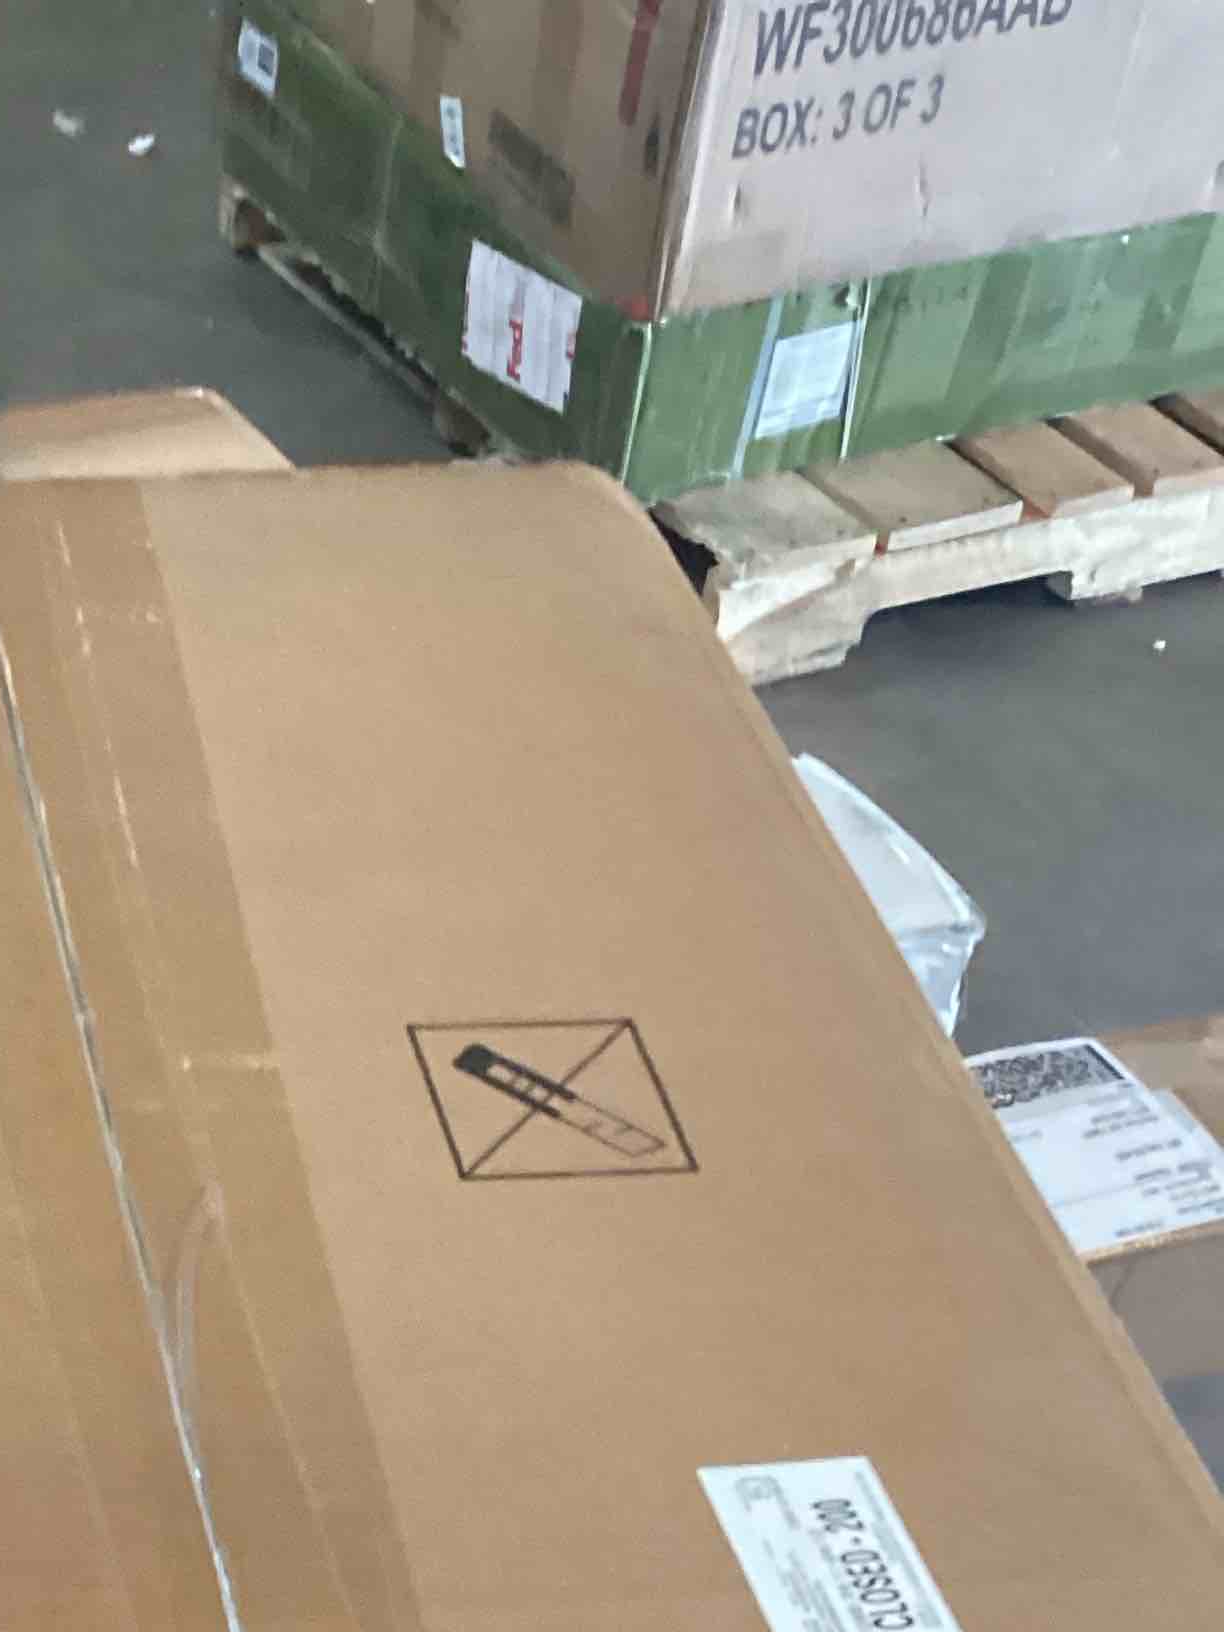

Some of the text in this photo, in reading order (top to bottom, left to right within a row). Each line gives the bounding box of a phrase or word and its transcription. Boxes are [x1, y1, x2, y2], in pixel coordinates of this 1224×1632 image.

[731, 74, 946, 160] BOX: 3 OF 3
